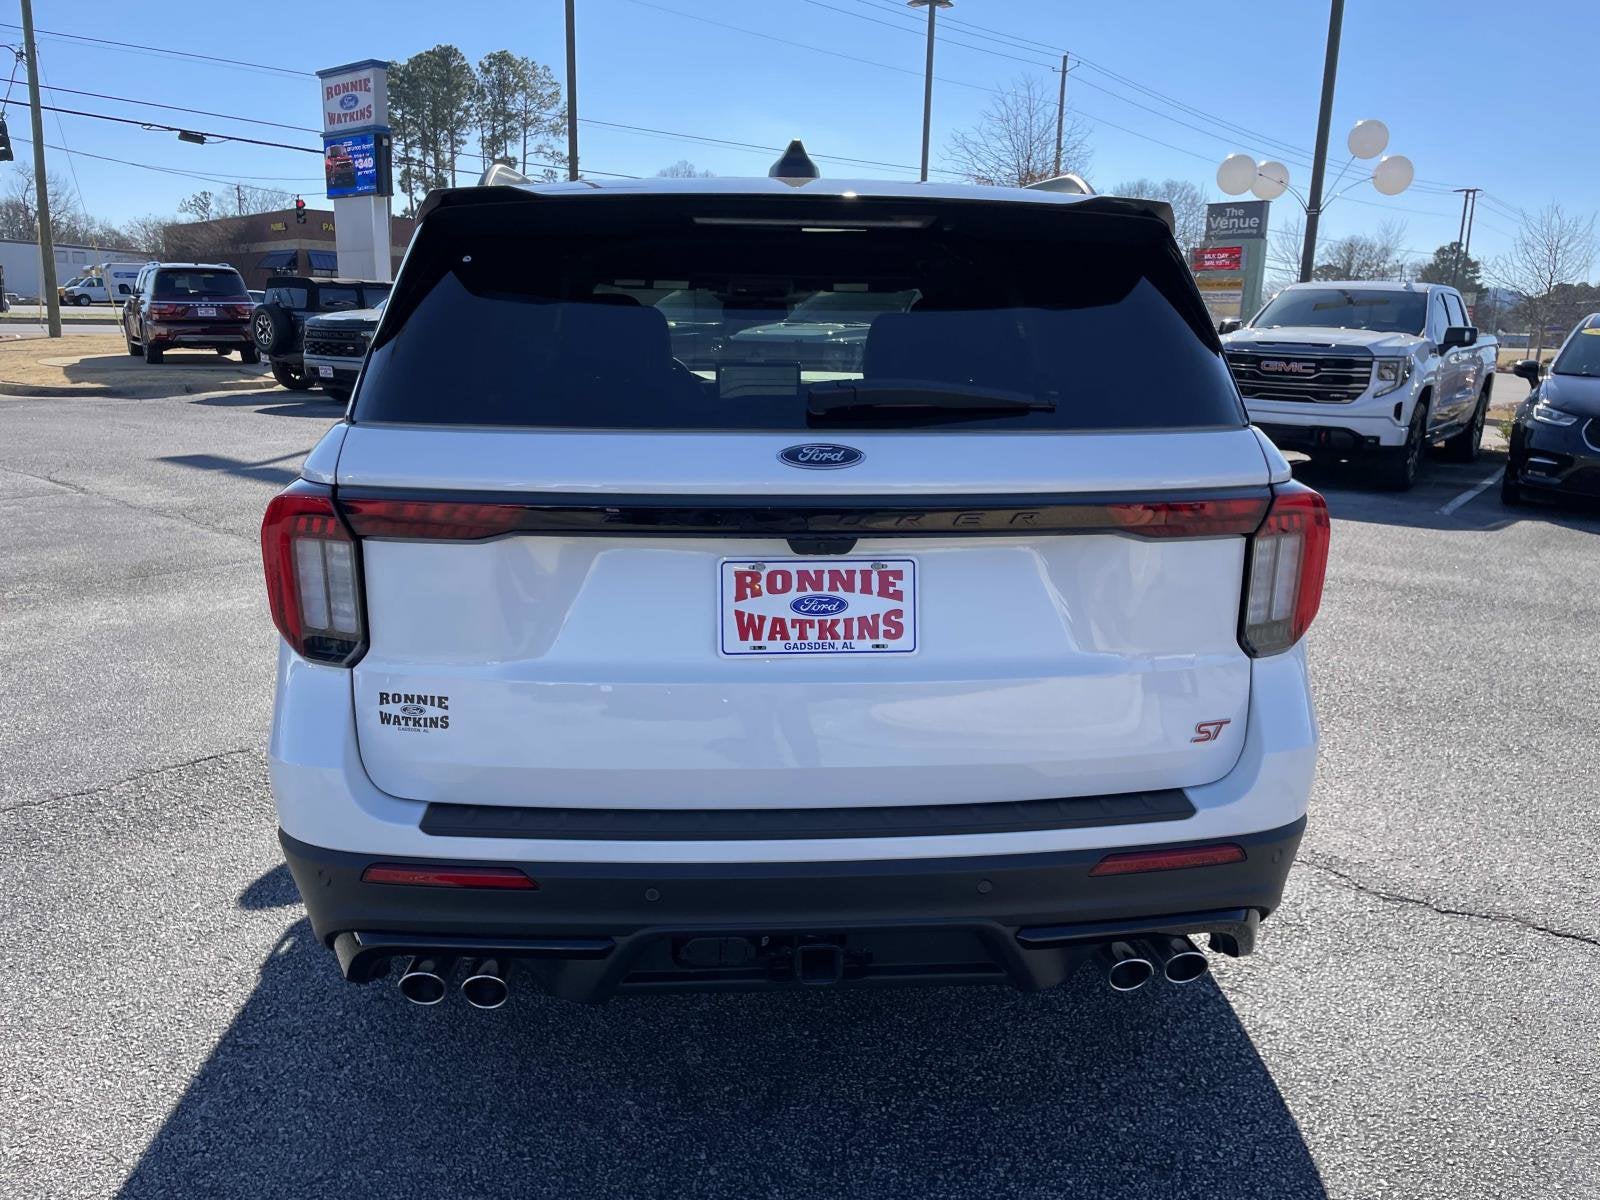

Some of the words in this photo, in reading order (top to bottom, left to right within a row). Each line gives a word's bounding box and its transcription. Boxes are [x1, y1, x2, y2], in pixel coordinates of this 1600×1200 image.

[326, 78, 371, 100] RONNIE
[327, 104, 372, 126] WATKINS
[1225, 207, 1245, 216] The
[1209, 216, 1260, 229] Venue
[1260, 360, 1316, 374] GMC
[733, 569, 904, 603] RONNIE
[799, 597, 840, 612] Ford
[733, 608, 905, 642] WATKINS
[784, 642, 839, 651] GADSDEN,
[841, 641, 856, 650] AL
[378, 691, 449, 711] RONNIE
[378, 710, 450, 730] WATKINS
[1190, 718, 1231, 743] ST
